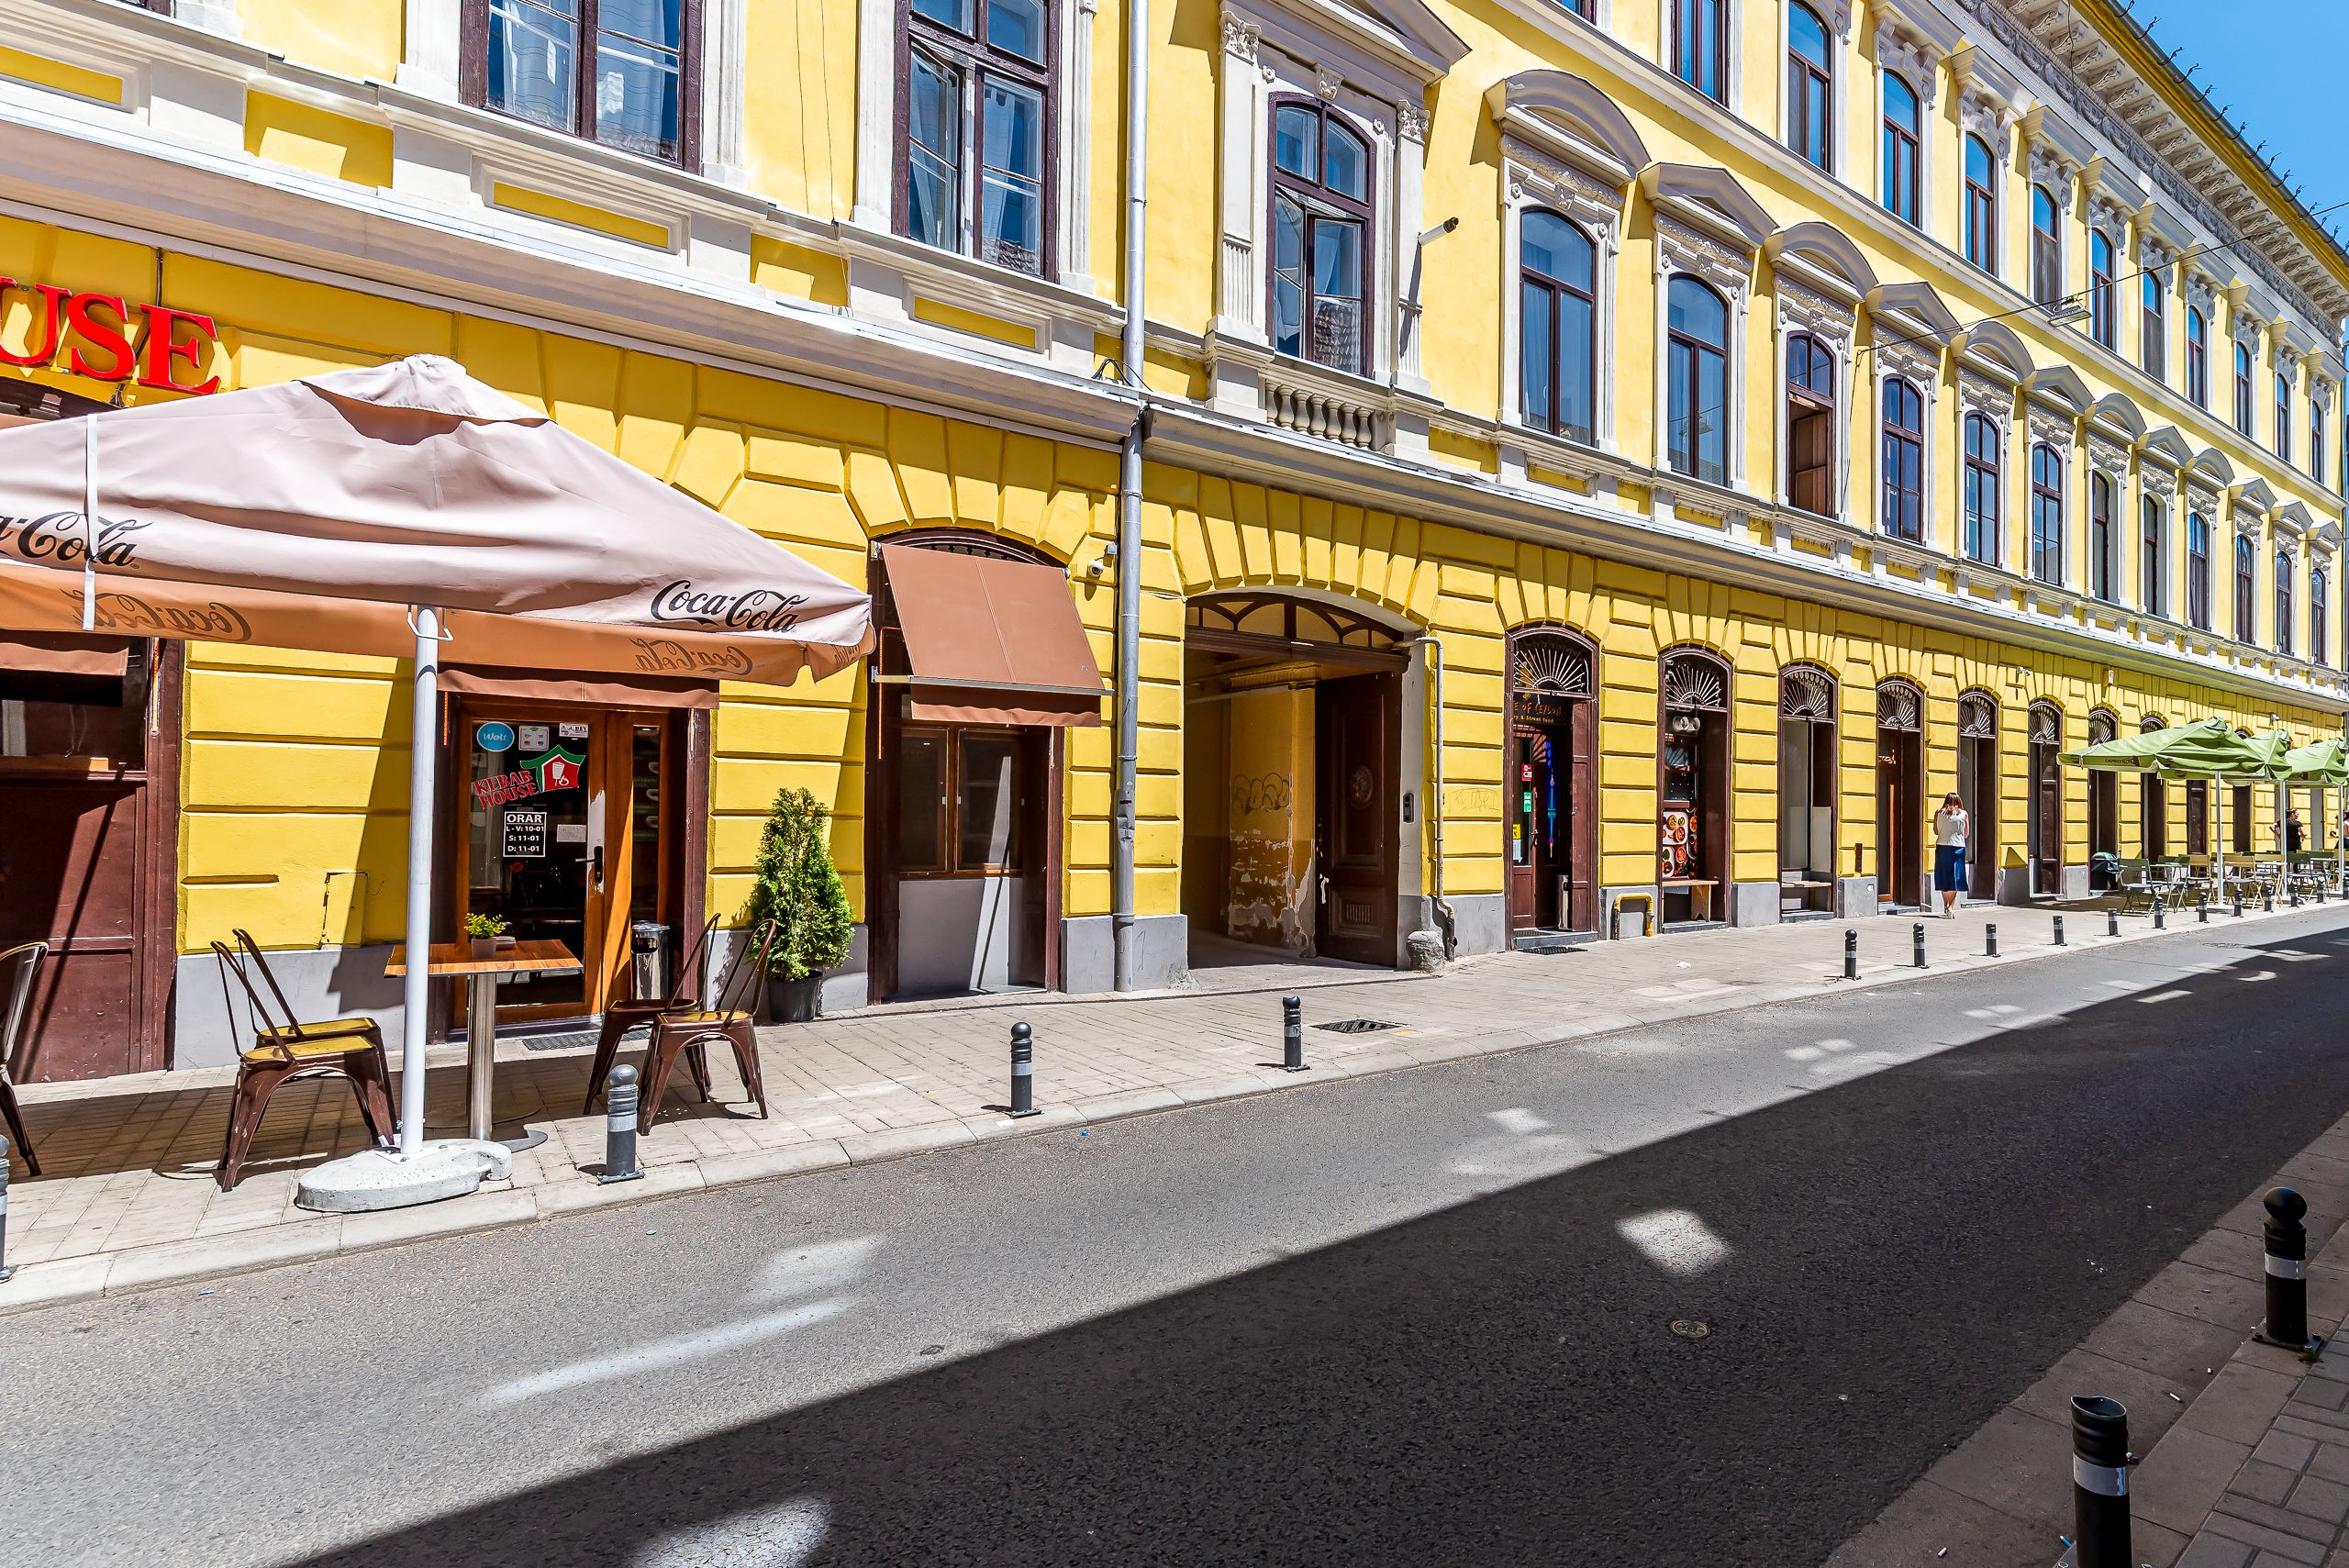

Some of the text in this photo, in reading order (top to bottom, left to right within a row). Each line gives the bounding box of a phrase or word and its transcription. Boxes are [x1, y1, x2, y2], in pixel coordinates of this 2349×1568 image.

[0, 276, 221, 395] USE
[651, 579, 810, 634] Coca-Cola
[483, 732, 507, 741] Wolt
[473, 770, 533, 795] KEBAB
[477, 783, 540, 810] HOUSE
[507, 814, 542, 823] ORAR
